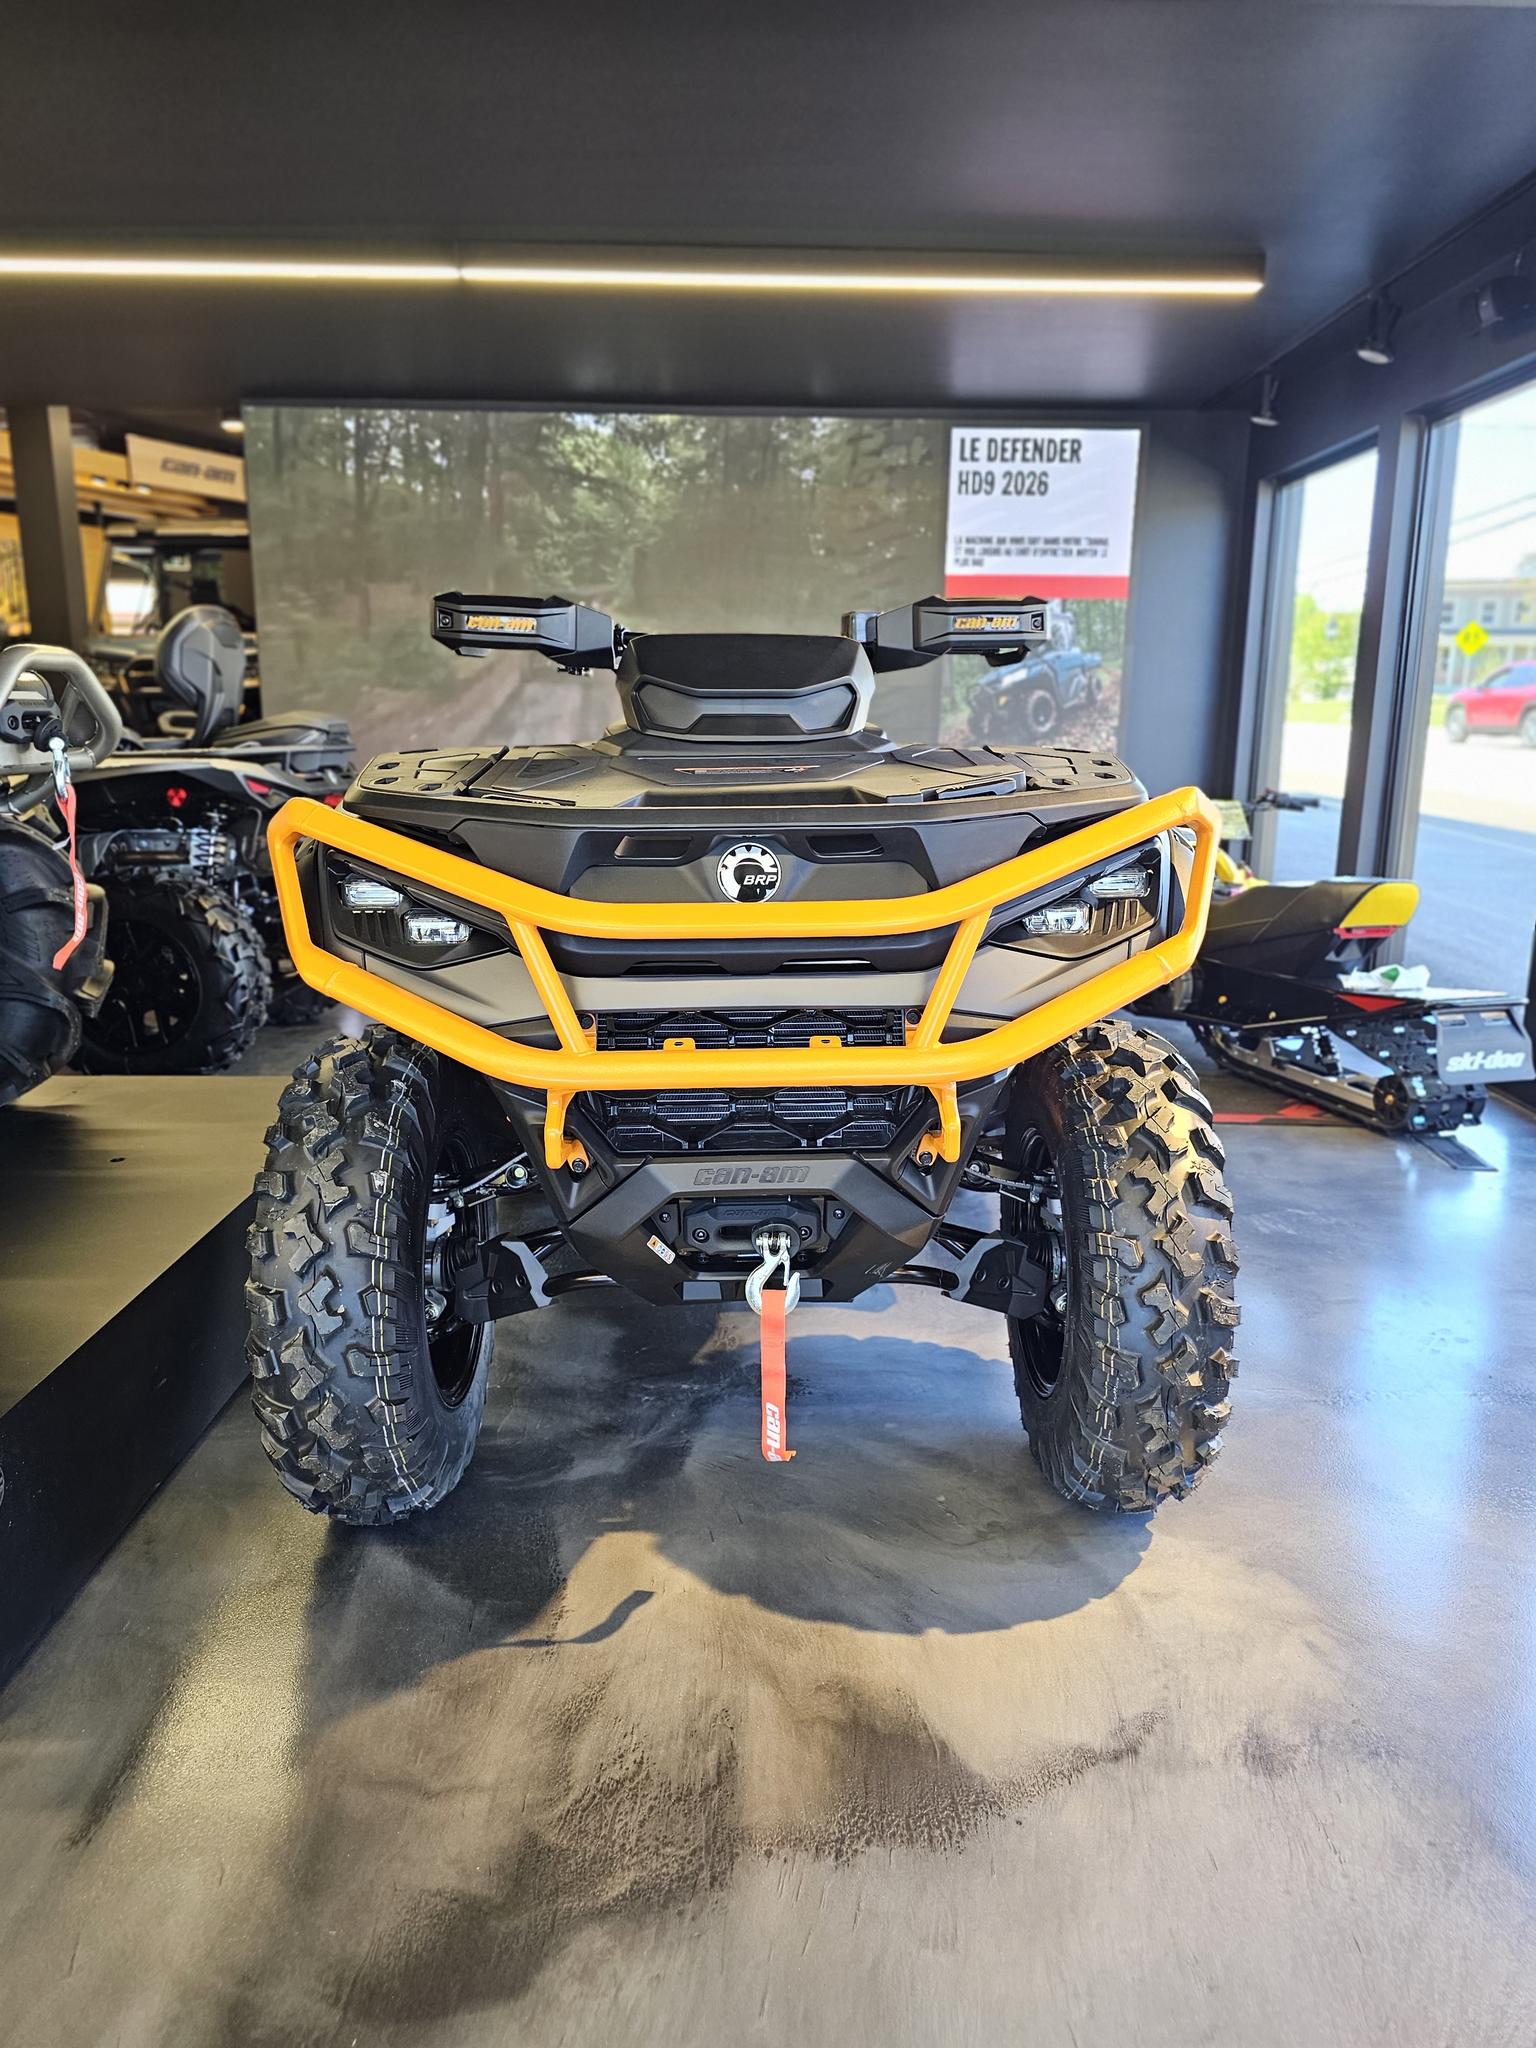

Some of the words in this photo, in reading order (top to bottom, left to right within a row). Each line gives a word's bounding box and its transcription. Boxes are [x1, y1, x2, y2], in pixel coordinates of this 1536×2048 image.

[959, 437, 980, 462] LE
[987, 438, 1082, 463] DEFENDER
[957, 471, 995, 495] HD9
[1001, 471, 1049, 496] 2026
[743, 874, 778, 886] BRP
[693, 1165, 810, 1186] can-am
